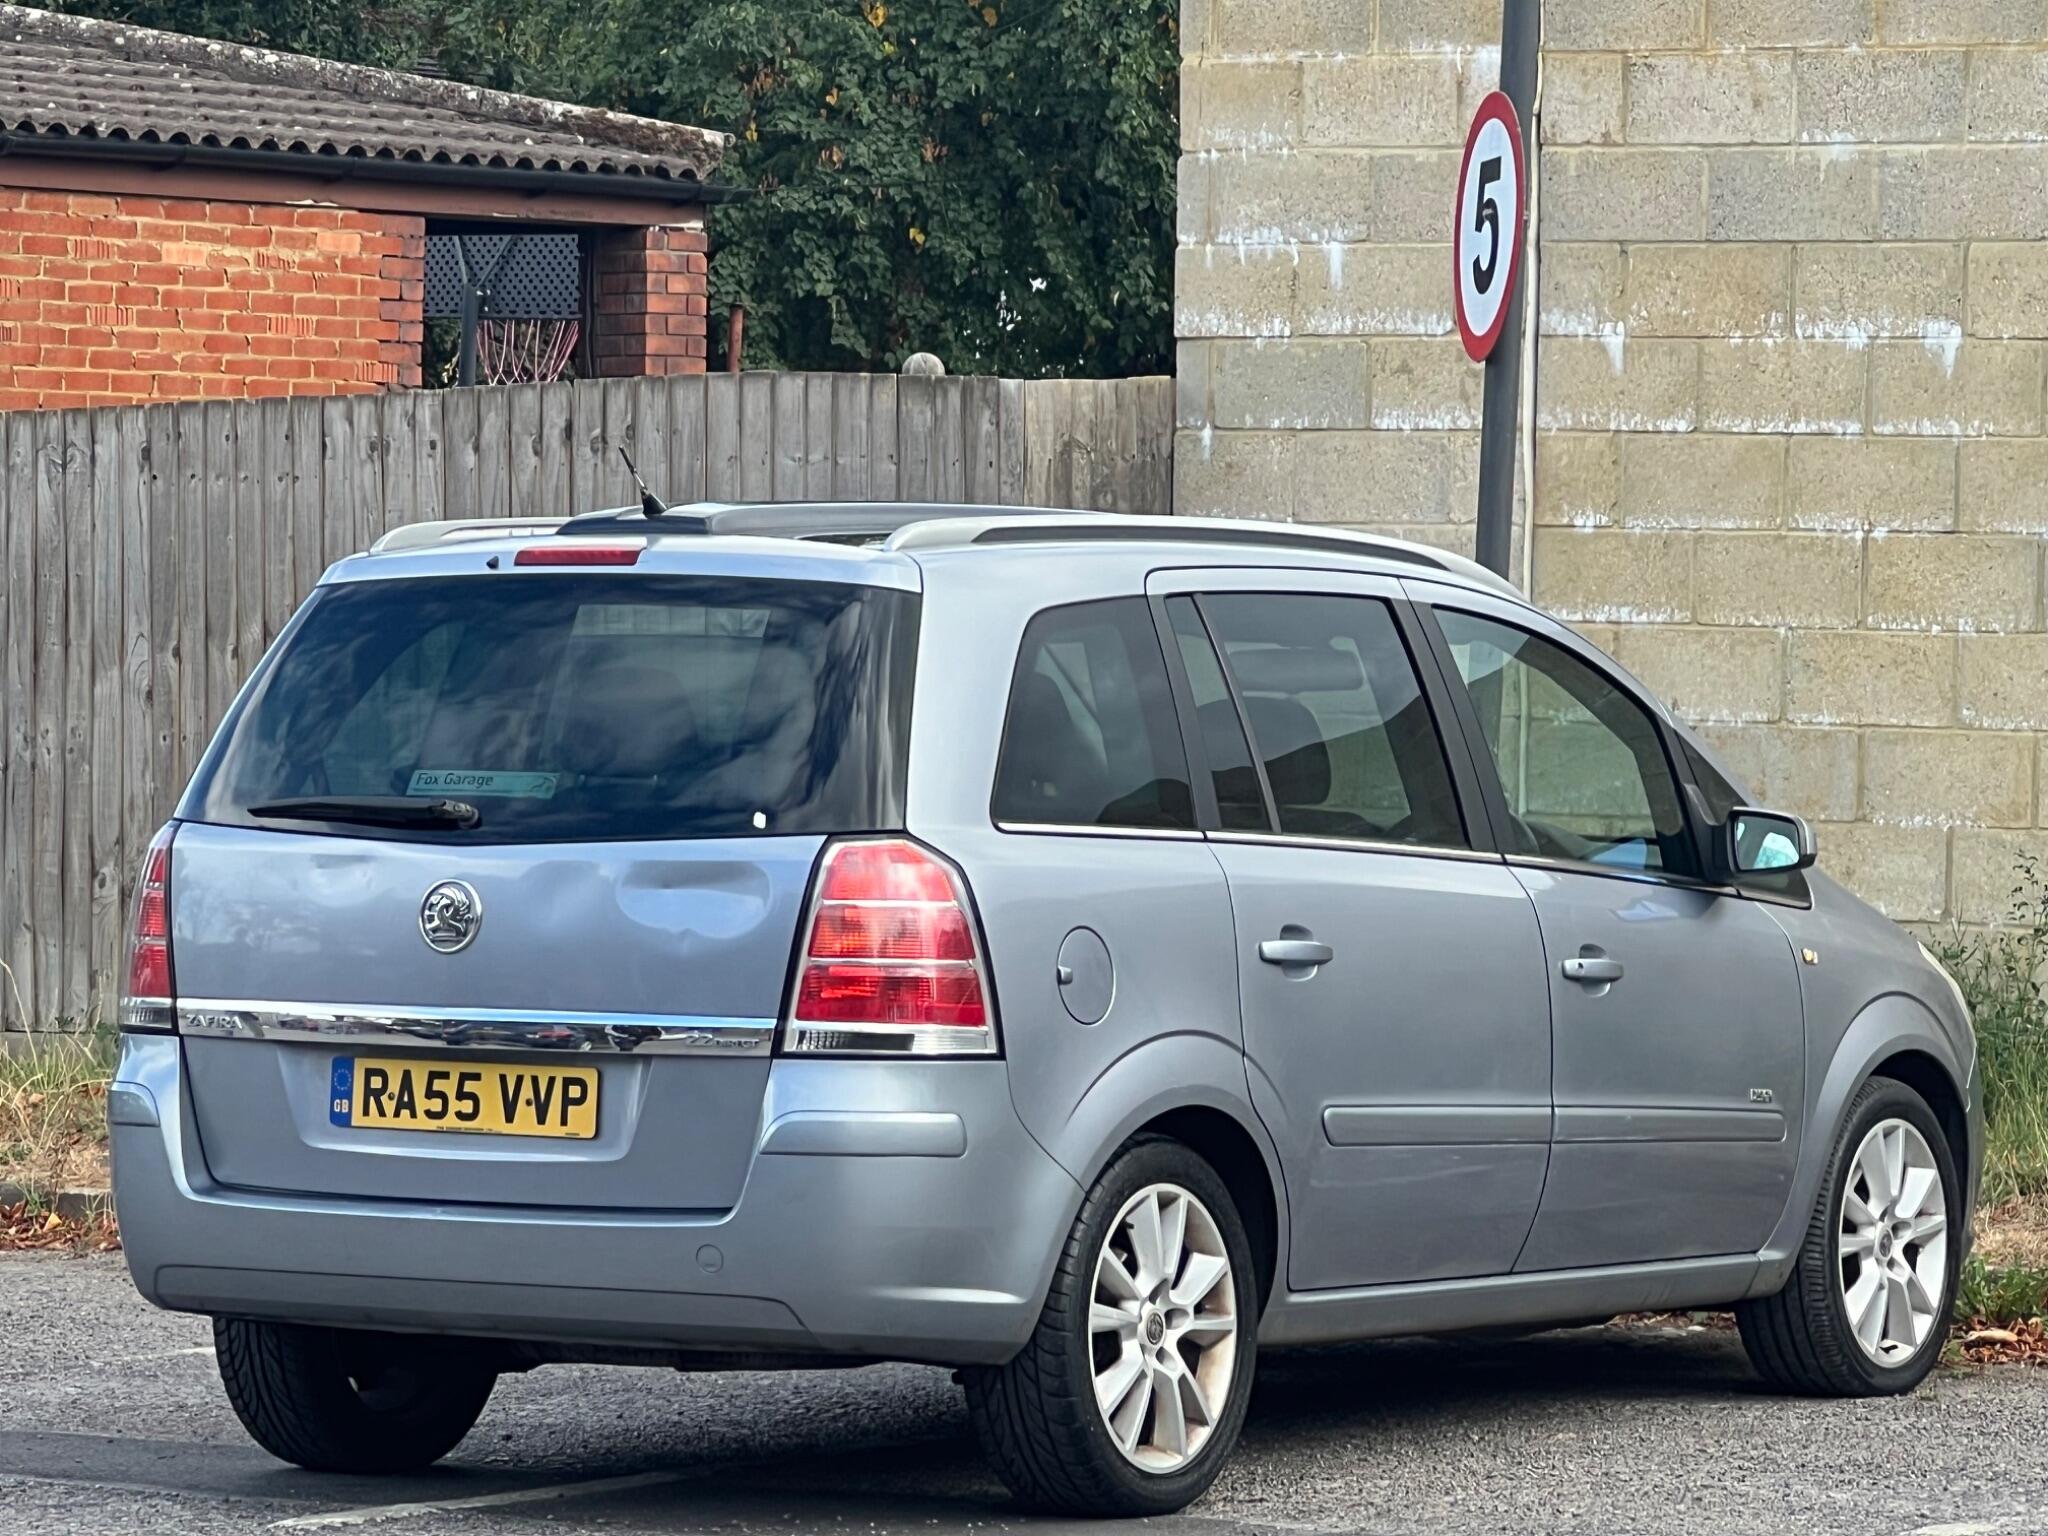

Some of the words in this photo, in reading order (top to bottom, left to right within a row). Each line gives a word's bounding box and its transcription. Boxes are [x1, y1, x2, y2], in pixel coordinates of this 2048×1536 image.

[1473, 156, 1502, 295] 5
[416, 773, 439, 785] Fox
[444, 773, 494, 788] Garage
[186, 1014, 243, 1029] ZAFIRA
[362, 1067, 482, 1122] RA55
[499, 1073, 589, 1127] VVP
[333, 1099, 349, 1113] GB
